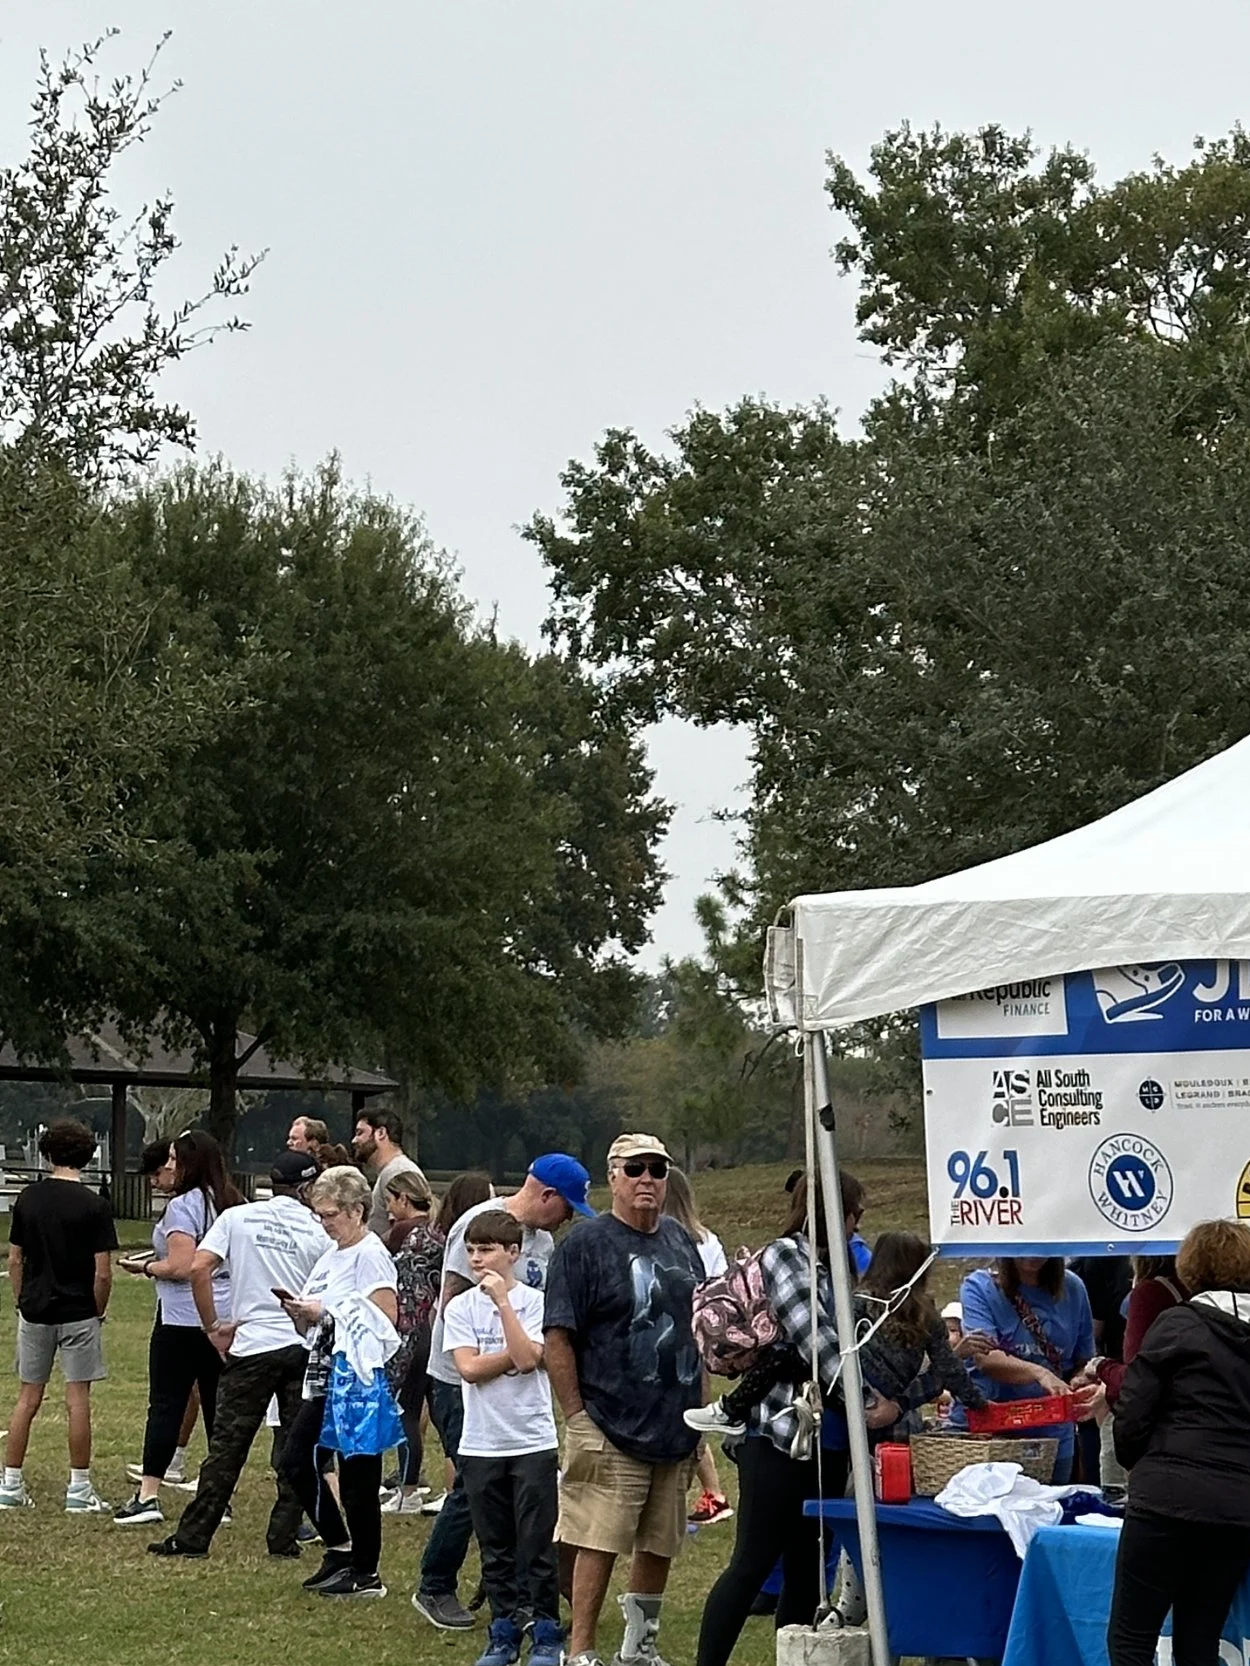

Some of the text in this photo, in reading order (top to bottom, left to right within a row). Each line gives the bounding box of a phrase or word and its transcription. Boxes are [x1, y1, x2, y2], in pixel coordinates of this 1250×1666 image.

[1003, 1003, 1051, 1016] FINANCE
[1194, 1009, 1222, 1022] FOR
[1225, 1009, 1236, 1020] A
[1037, 1068, 1091, 1088] All South
[1039, 1088, 1104, 1110] Consulting
[1040, 1107, 1101, 1130] Engineers
[1094, 1138, 1164, 1177] HANCOCK
[947, 1149, 1021, 1199] 96.1
[960, 1199, 1023, 1226] RIVER
[1098, 1189, 1168, 1227] WHITNEY
